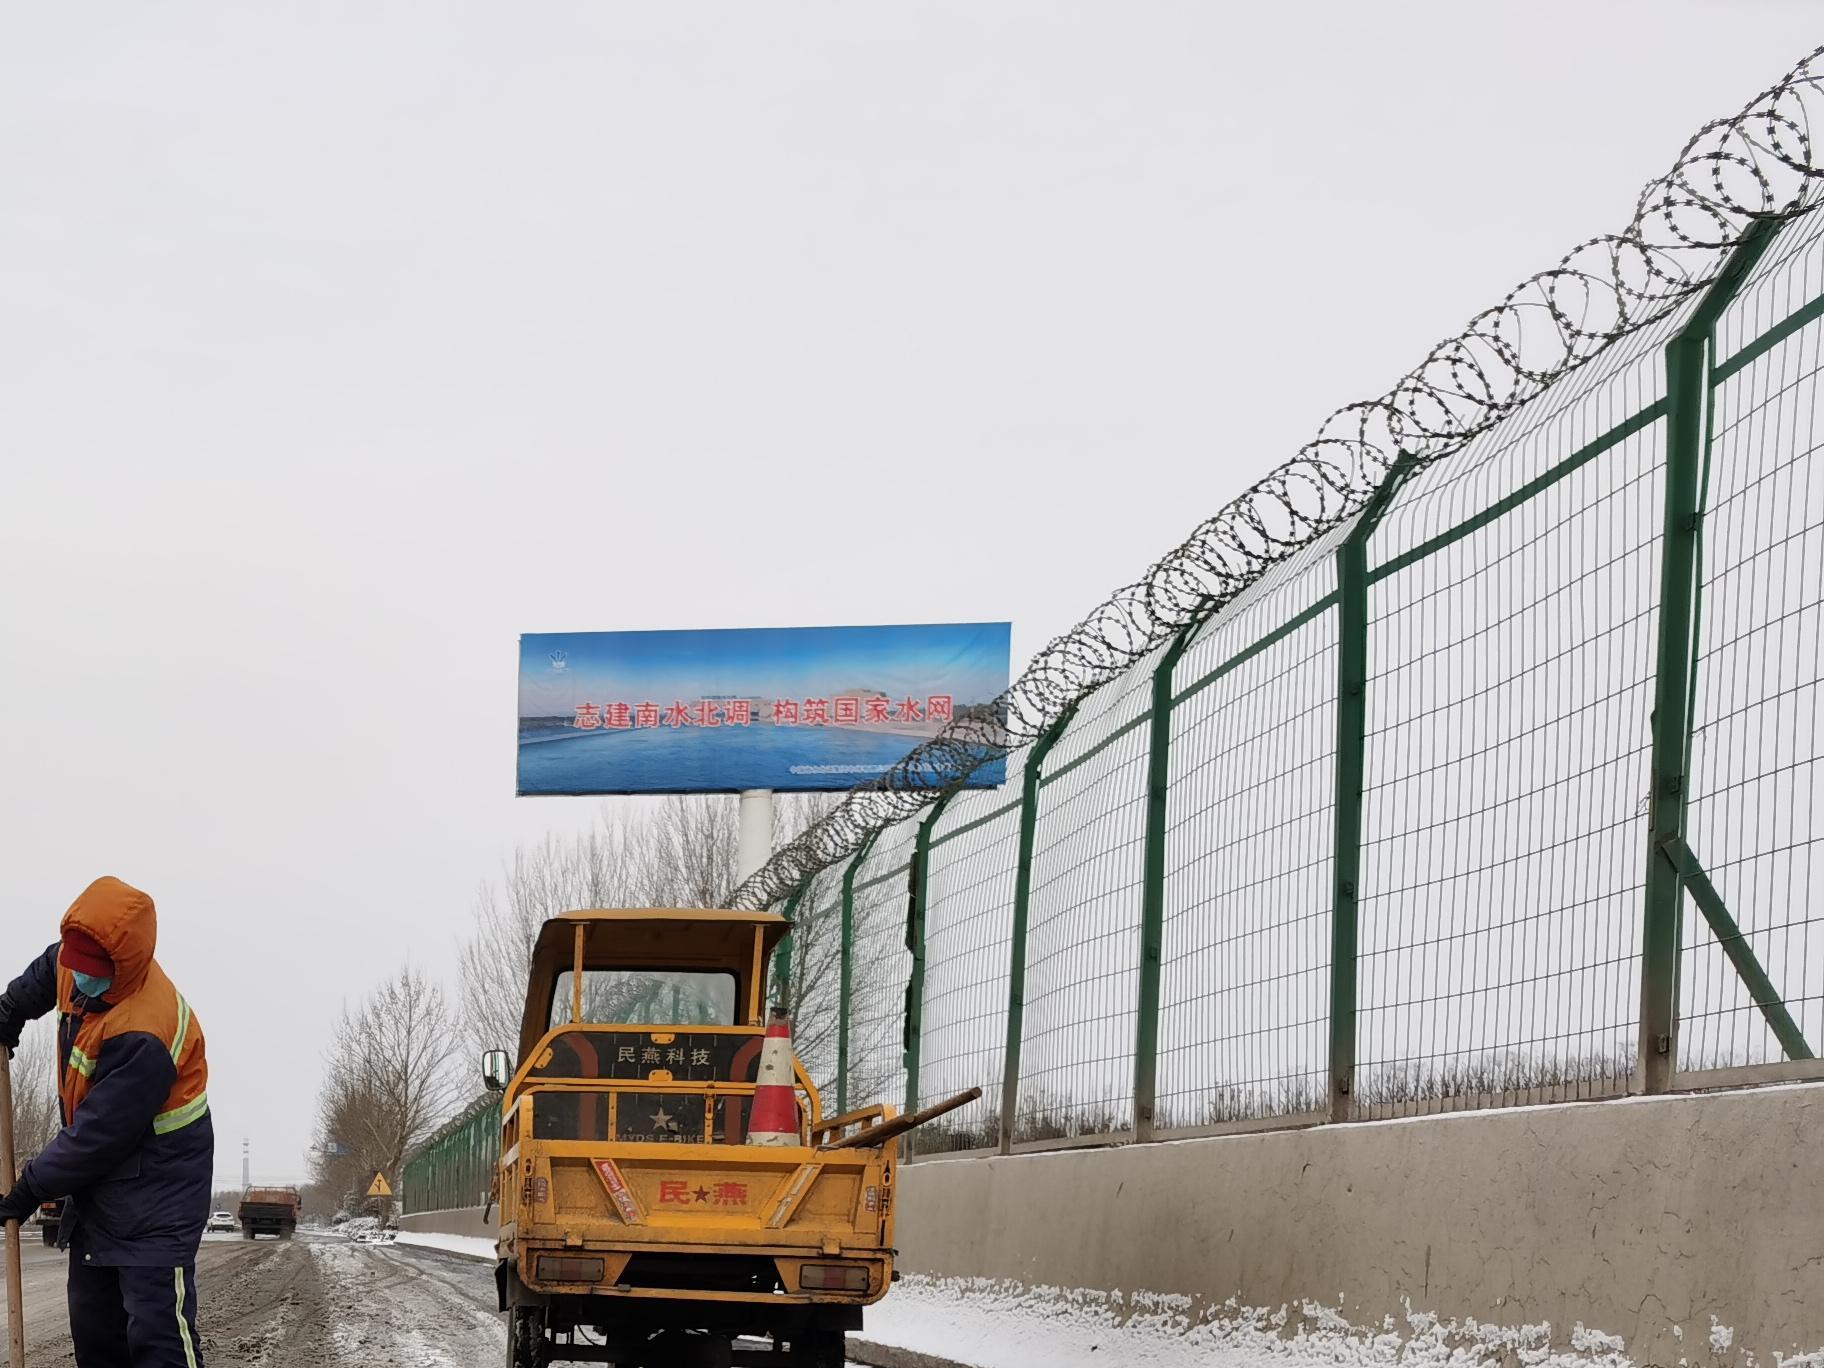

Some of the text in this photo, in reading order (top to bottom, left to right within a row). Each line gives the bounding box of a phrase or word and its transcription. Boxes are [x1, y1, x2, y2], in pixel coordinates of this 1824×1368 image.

[573, 694, 954, 730] 志建南水北调 构筑国家水网
[617, 1046, 711, 1066] 民燕科技
